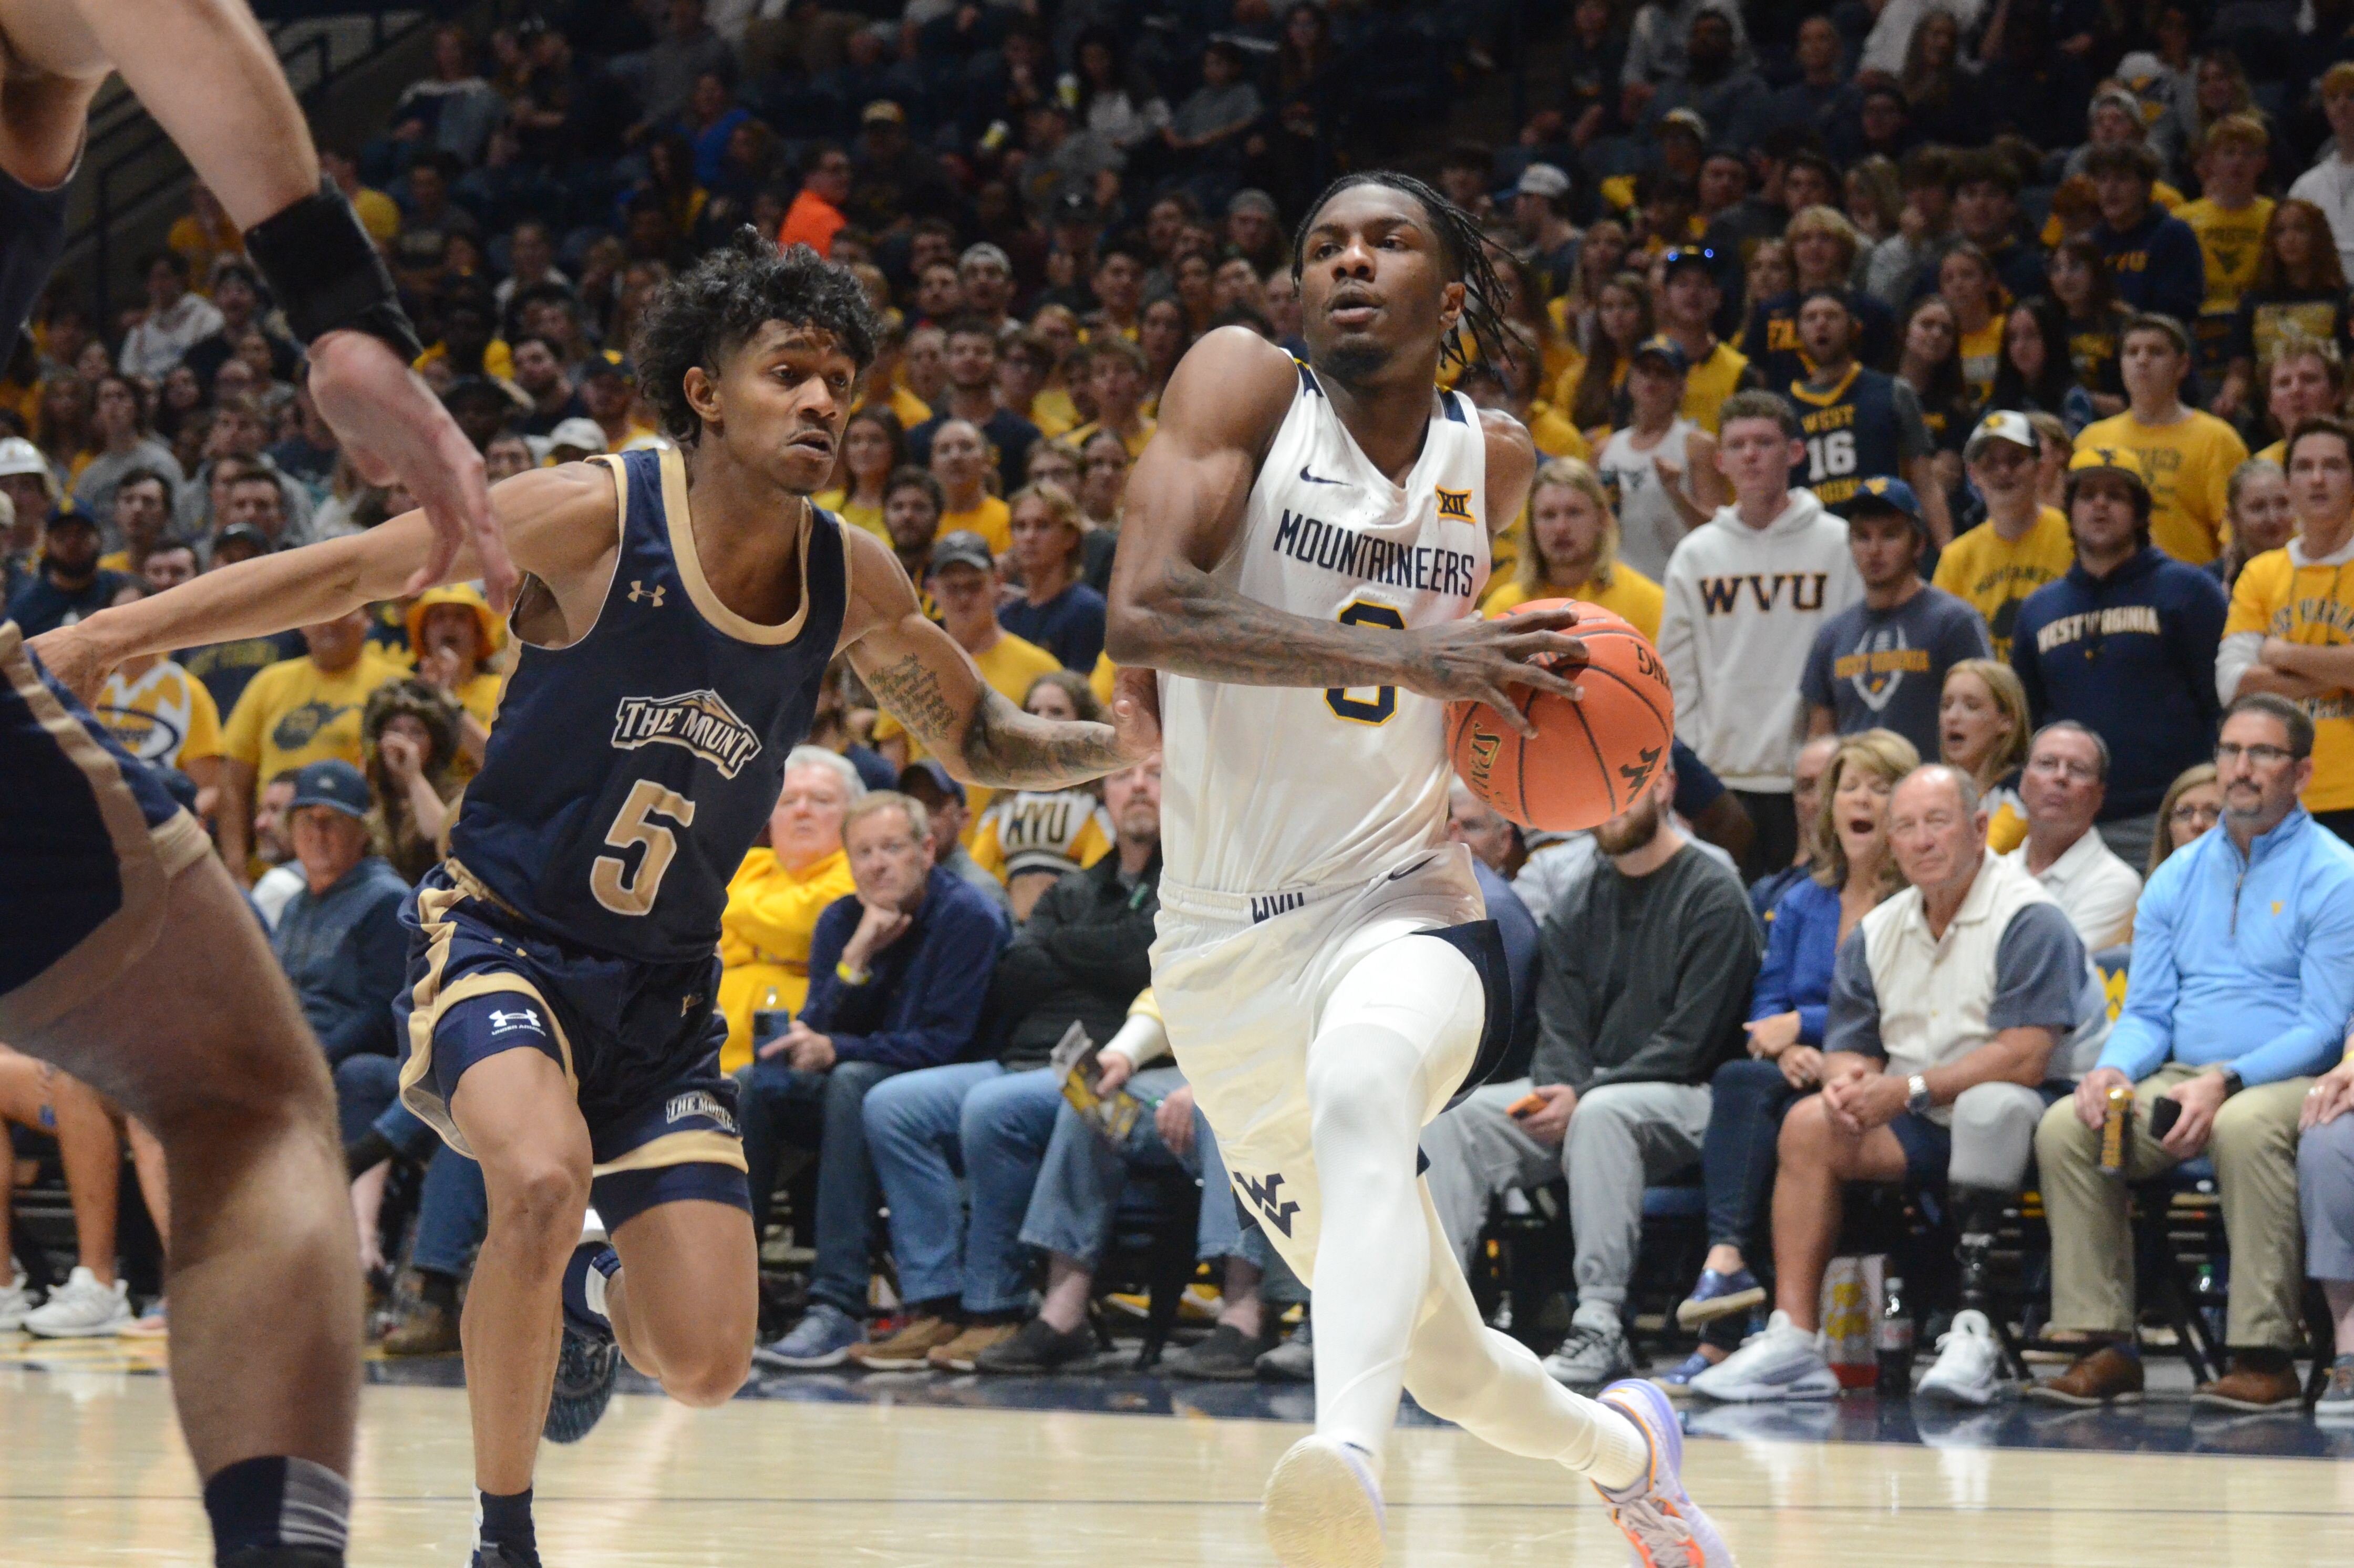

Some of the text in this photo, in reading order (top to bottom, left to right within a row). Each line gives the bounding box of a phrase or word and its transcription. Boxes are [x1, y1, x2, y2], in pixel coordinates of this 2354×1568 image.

[1806, 430, 1857, 482] 16
[1437, 489, 1472, 518] XII
[1273, 509, 1474, 597] MOUNTAINEERS
[1699, 572, 1827, 614] WVU
[2037, 614, 2083, 654] WEST
[621, 703, 683, 738] THE
[590, 779, 696, 916] 5
[491, 1025, 518, 1036] UNDER
[669, 1096, 695, 1117] THE
